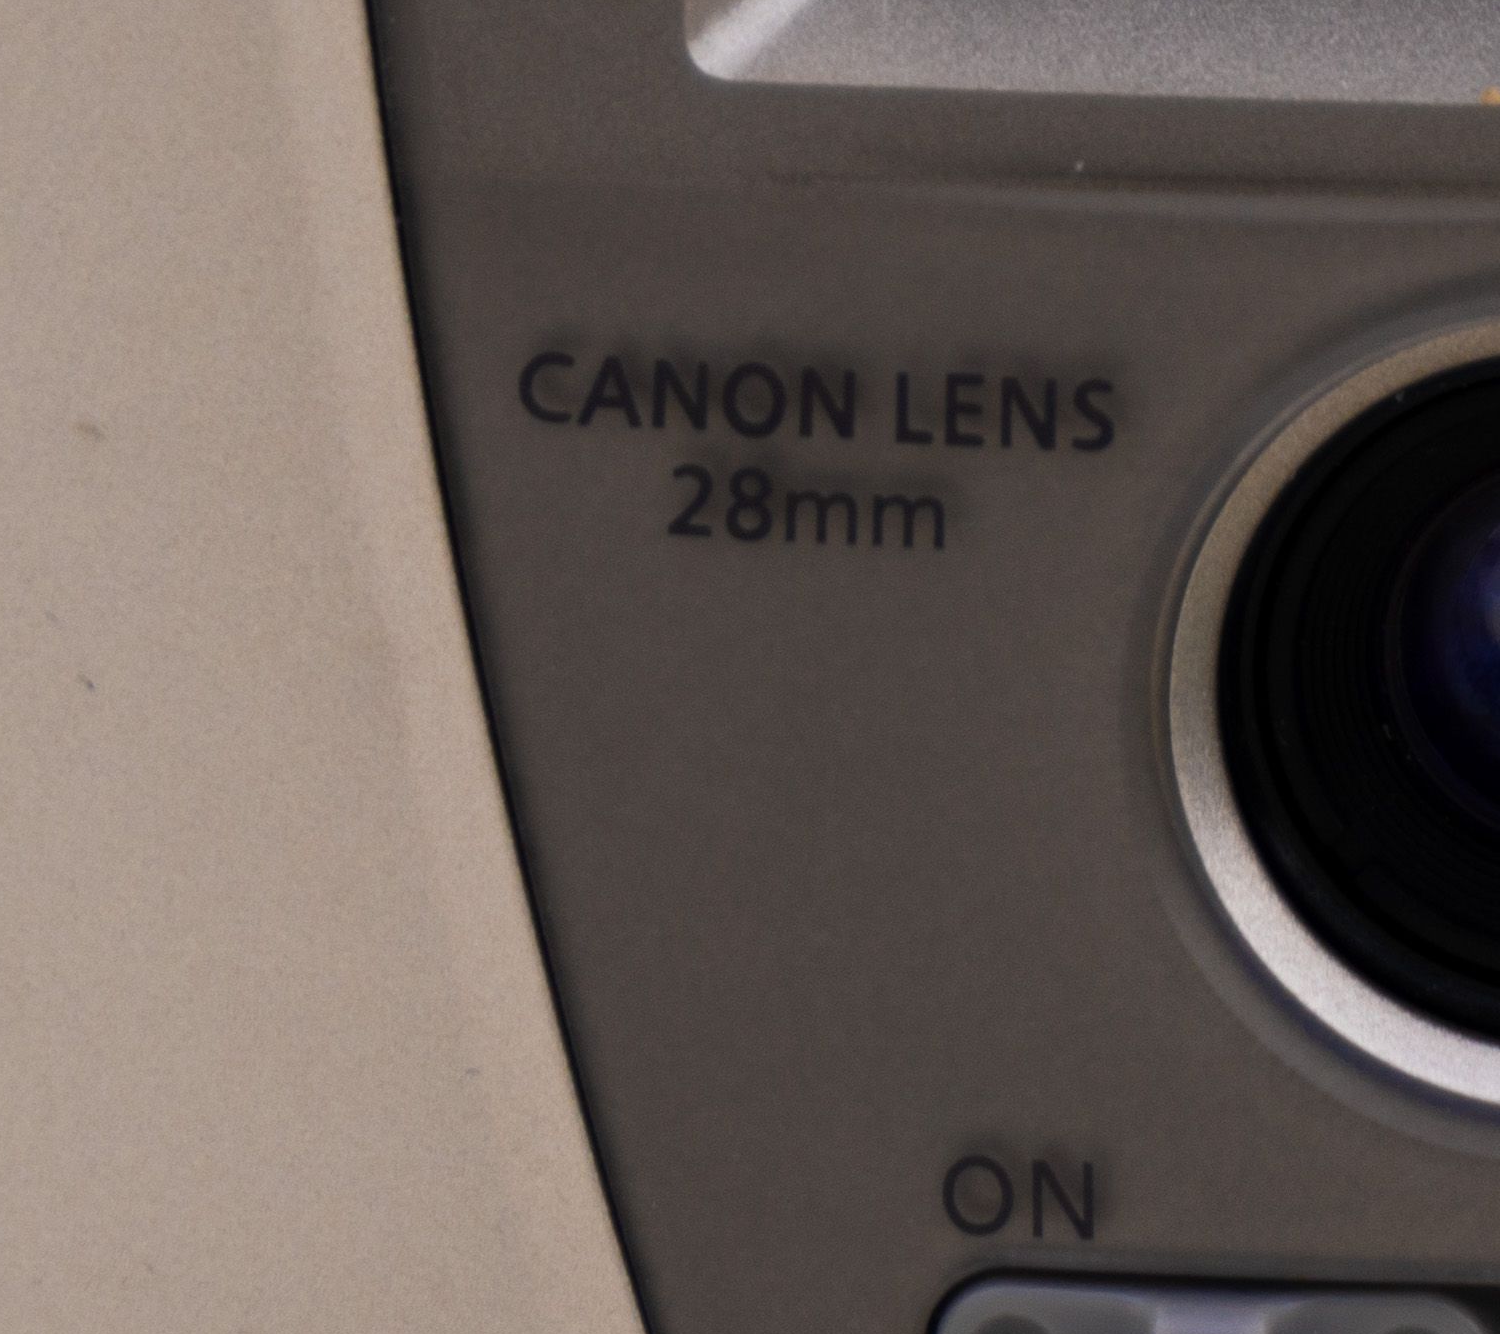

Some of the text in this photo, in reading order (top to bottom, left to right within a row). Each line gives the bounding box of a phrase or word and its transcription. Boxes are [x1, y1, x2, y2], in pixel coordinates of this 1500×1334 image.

[518, 351, 1115, 452] CANON LENS
[666, 463, 947, 551] 28mm
[941, 1155, 1096, 1240] ON
